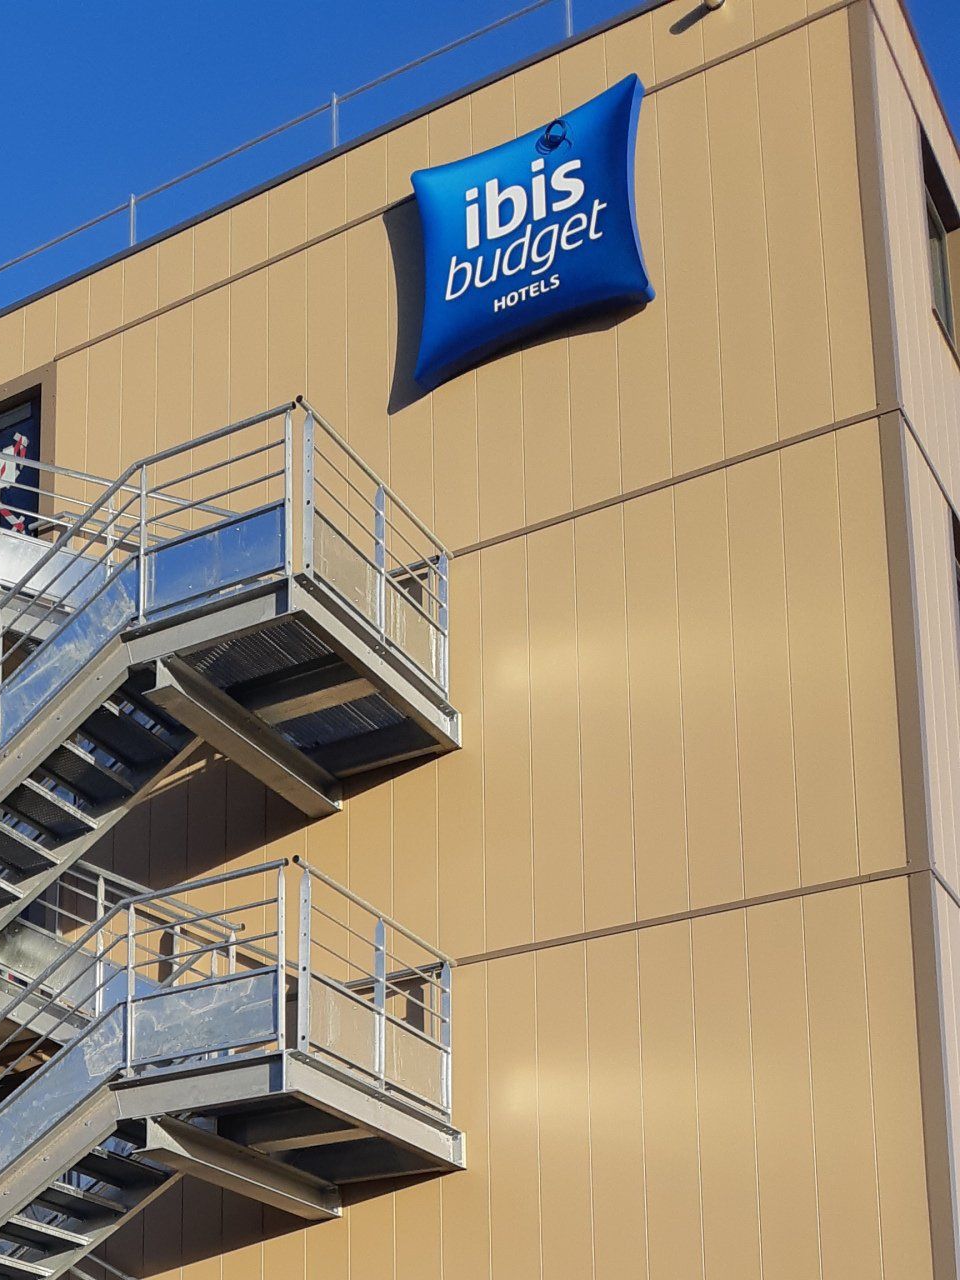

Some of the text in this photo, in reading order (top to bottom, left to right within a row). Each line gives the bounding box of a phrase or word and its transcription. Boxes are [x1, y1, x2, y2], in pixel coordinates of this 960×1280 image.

[465, 158, 585, 249] ibis
[445, 199, 607, 300] budget
[493, 274, 560, 312] HOTELS
